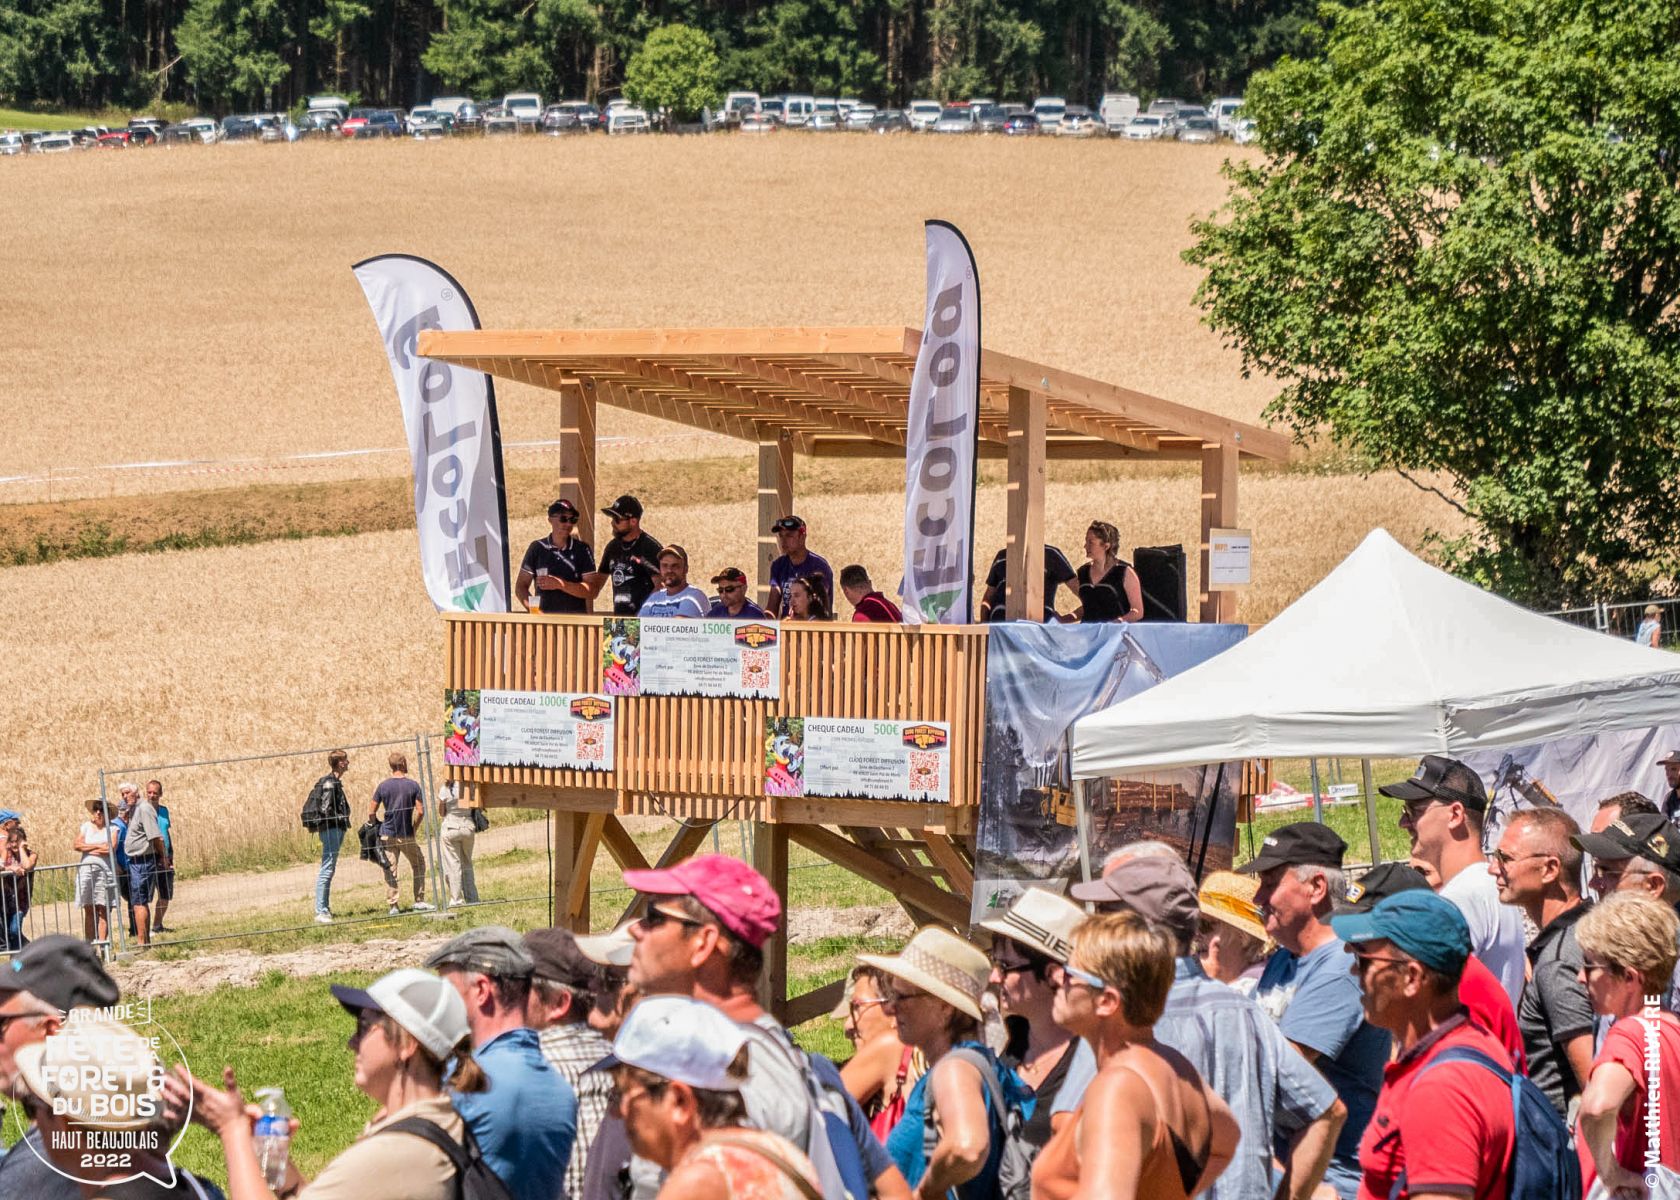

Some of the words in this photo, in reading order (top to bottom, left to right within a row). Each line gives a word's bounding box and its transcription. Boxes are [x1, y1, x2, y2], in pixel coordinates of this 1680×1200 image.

[643, 624, 670, 633] CHEQUE
[671, 625, 699, 634] CADEAU
[702, 622, 732, 634] 1500€
[483, 696, 509, 705] CHEQUE
[510, 696, 536, 706] CADEAU
[539, 695, 569, 707] 1000€
[807, 724, 836, 734] CHEQUE
[836, 724, 865, 734] CADEAU
[873, 723, 900, 736] 500€
